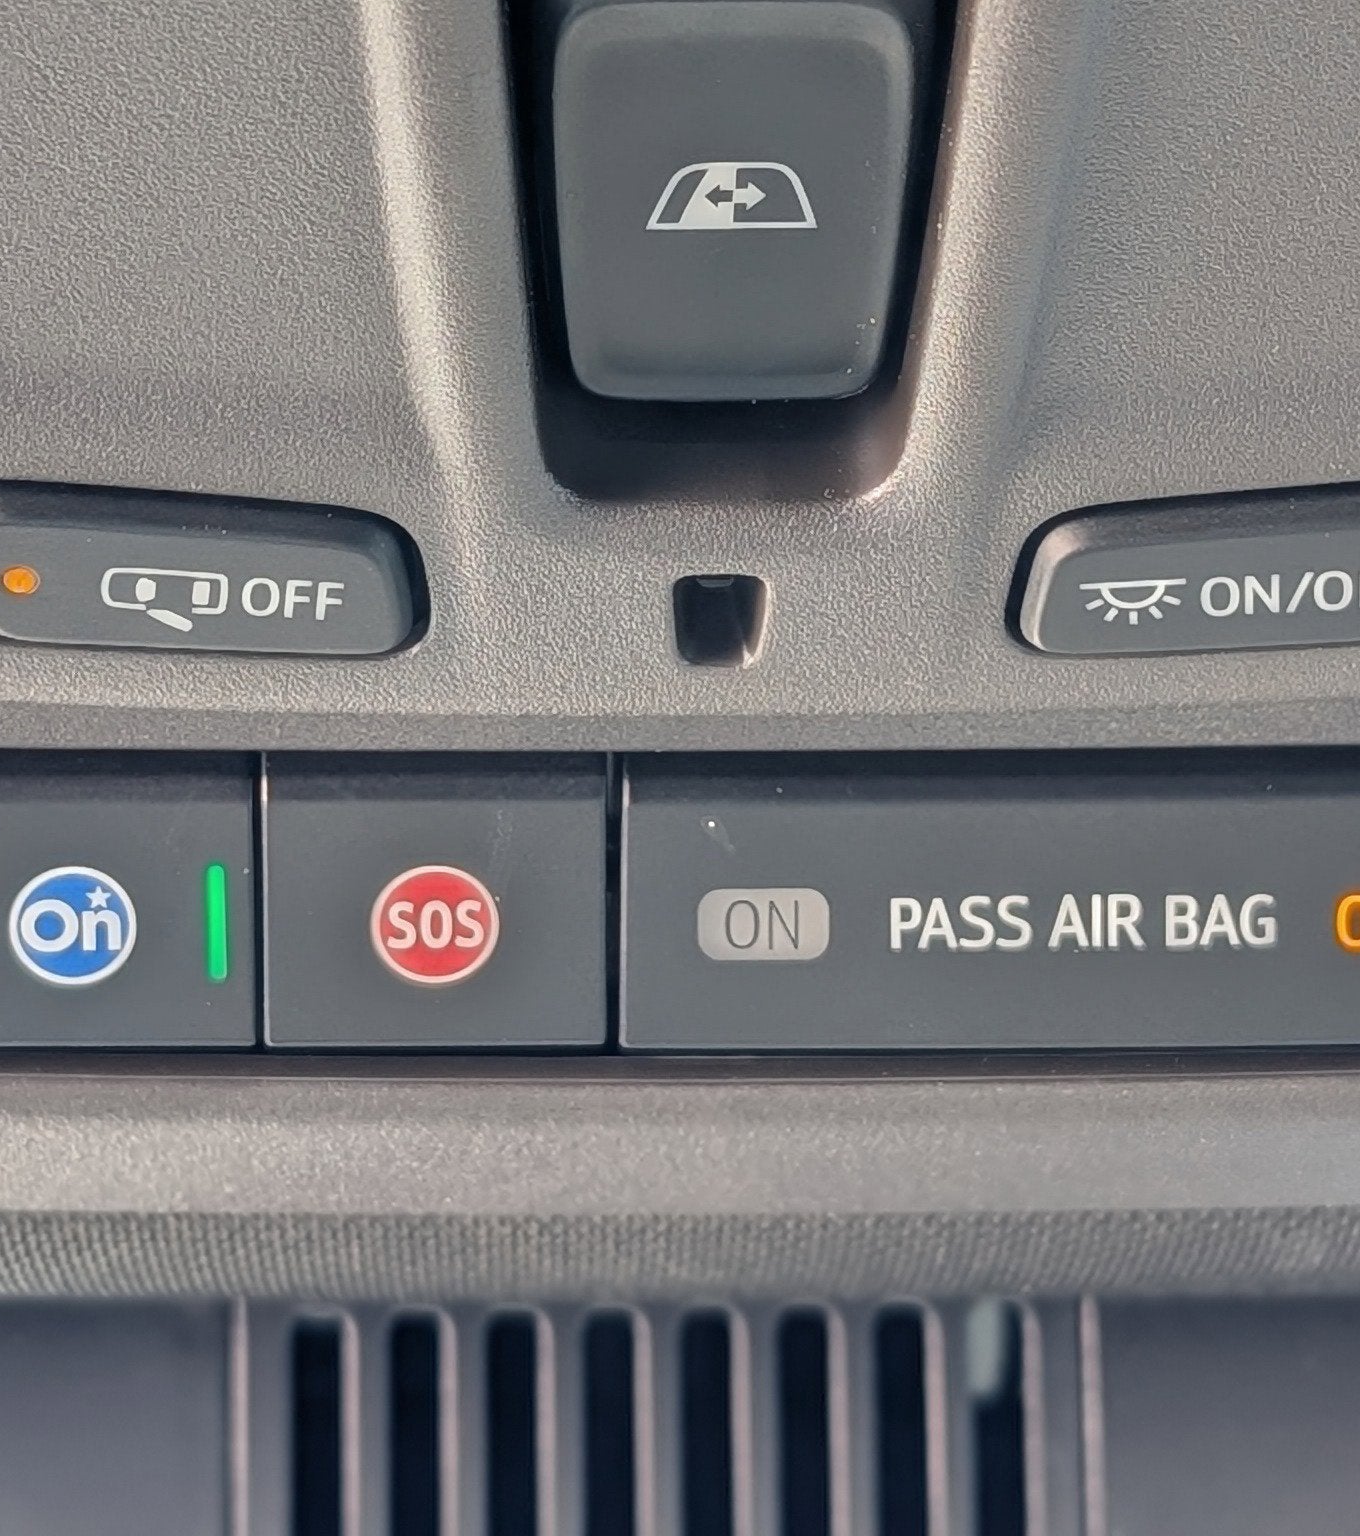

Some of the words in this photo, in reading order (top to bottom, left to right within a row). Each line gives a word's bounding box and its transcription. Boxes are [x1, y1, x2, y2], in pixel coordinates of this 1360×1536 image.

[241, 578, 345, 621] OFF
[20, 898, 121, 952] On
[385, 899, 485, 950] SOS
[724, 898, 802, 952] ON
[887, 894, 1031, 951] PASS
[1047, 894, 1145, 951] AIR
[1164, 894, 1277, 951] BAG
